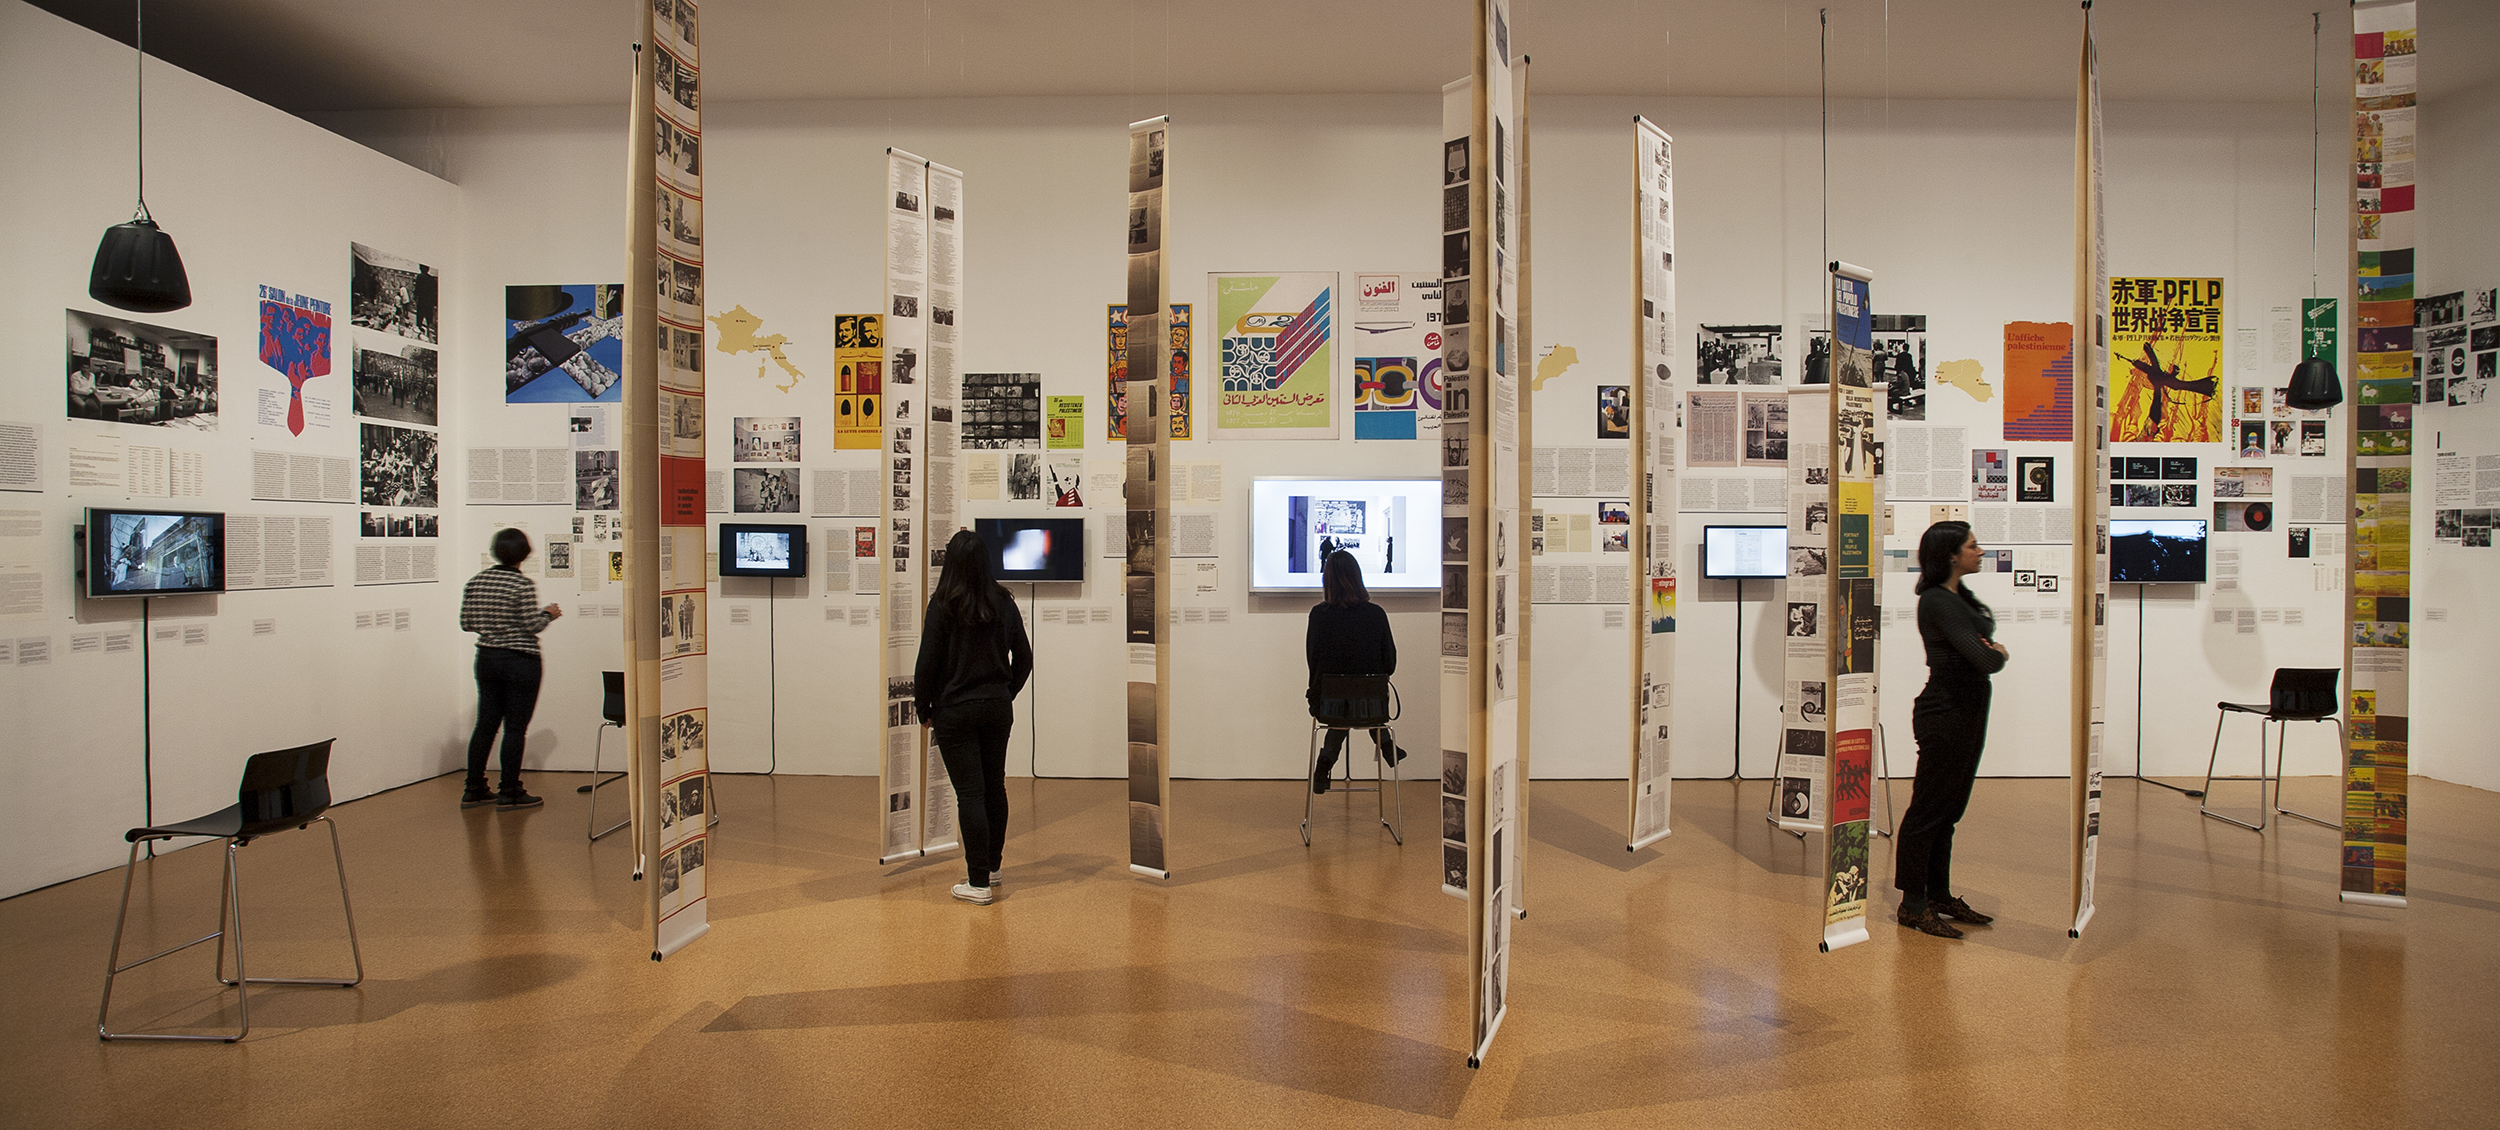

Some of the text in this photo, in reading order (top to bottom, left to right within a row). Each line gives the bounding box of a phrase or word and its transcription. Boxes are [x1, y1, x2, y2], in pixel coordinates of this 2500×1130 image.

[1363, 281, 1395, 297] الفنون
[1426, 312, 1442, 322] 197
[2007, 333, 2045, 342] L'affiche
[2007, 342, 2066, 352] palestinienne
[1444, 374, 1469, 383] Palestin
[1446, 382, 1469, 411] in
[1444, 411, 1469, 420] Palestin
